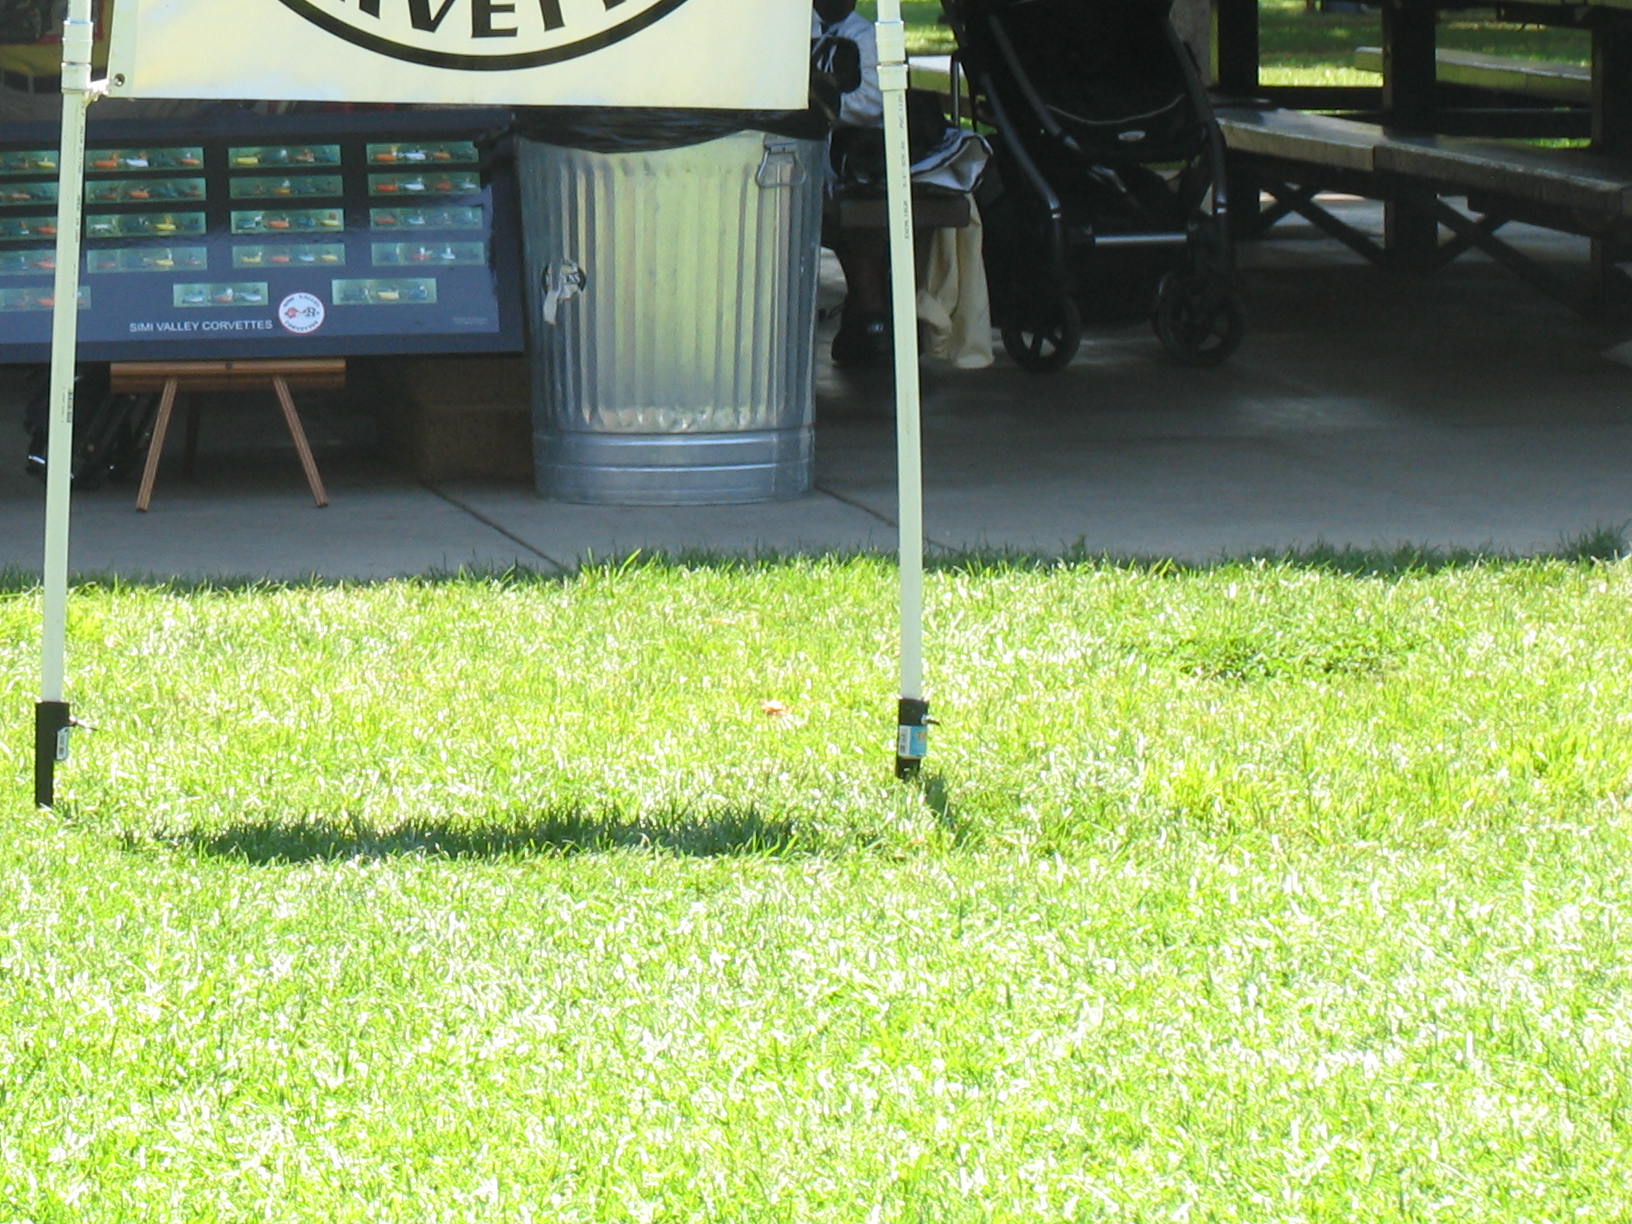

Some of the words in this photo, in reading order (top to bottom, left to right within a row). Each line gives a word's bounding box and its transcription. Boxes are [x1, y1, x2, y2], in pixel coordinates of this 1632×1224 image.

[129, 322, 154, 333] SIMI
[156, 321, 201, 332] VALLEY
[203, 319, 273, 332] CORVETTES
